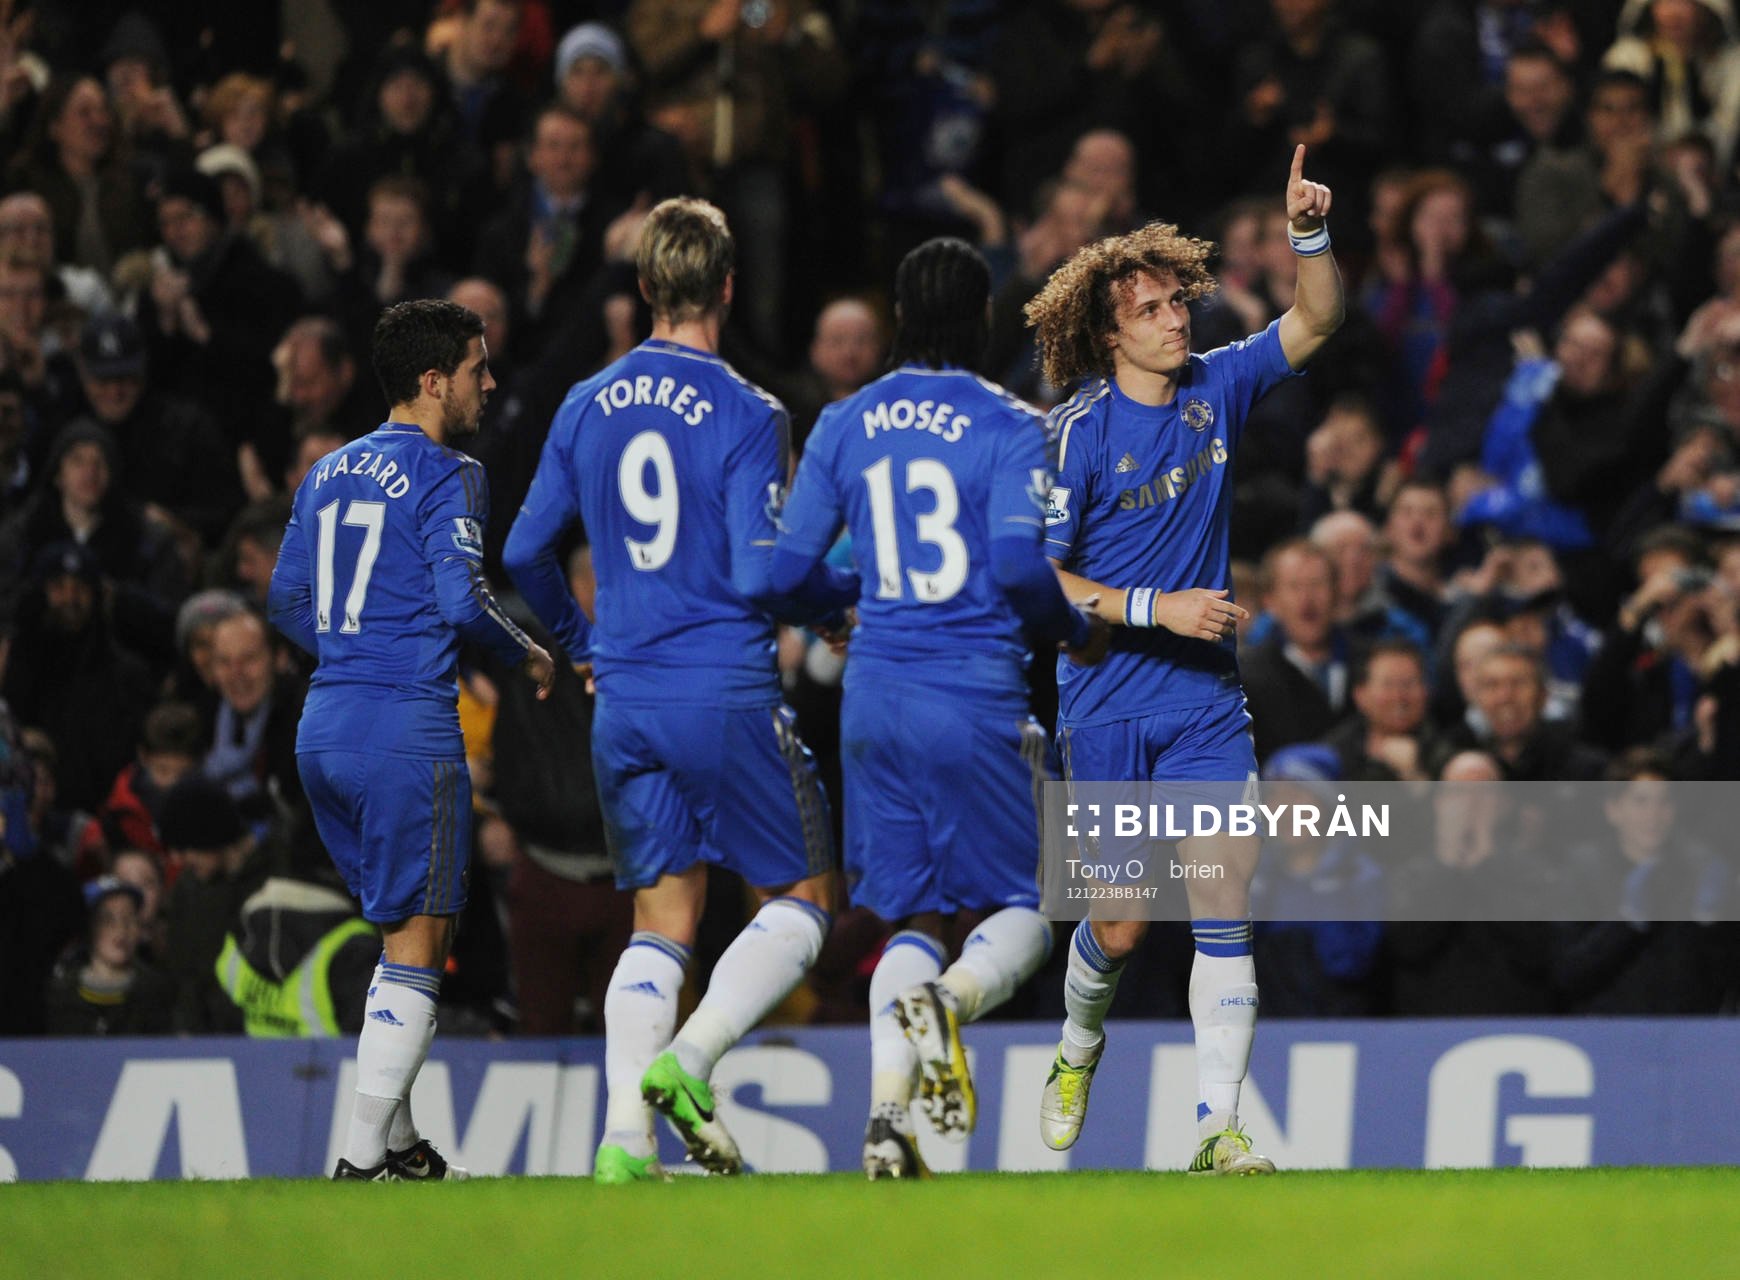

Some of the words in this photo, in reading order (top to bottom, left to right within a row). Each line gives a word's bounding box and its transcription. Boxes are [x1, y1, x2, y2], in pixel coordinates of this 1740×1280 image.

[594, 375, 713, 426] TORRES
[862, 398, 972, 443] MOSES
[314, 452, 411, 500] HAZARD
[617, 428, 680, 572] 9
[1120, 438, 1228, 511] SAMSUNG
[315, 498, 387, 634] 17
[861, 454, 971, 604] 13
[0, 1034, 1597, 1184] AMSNG
